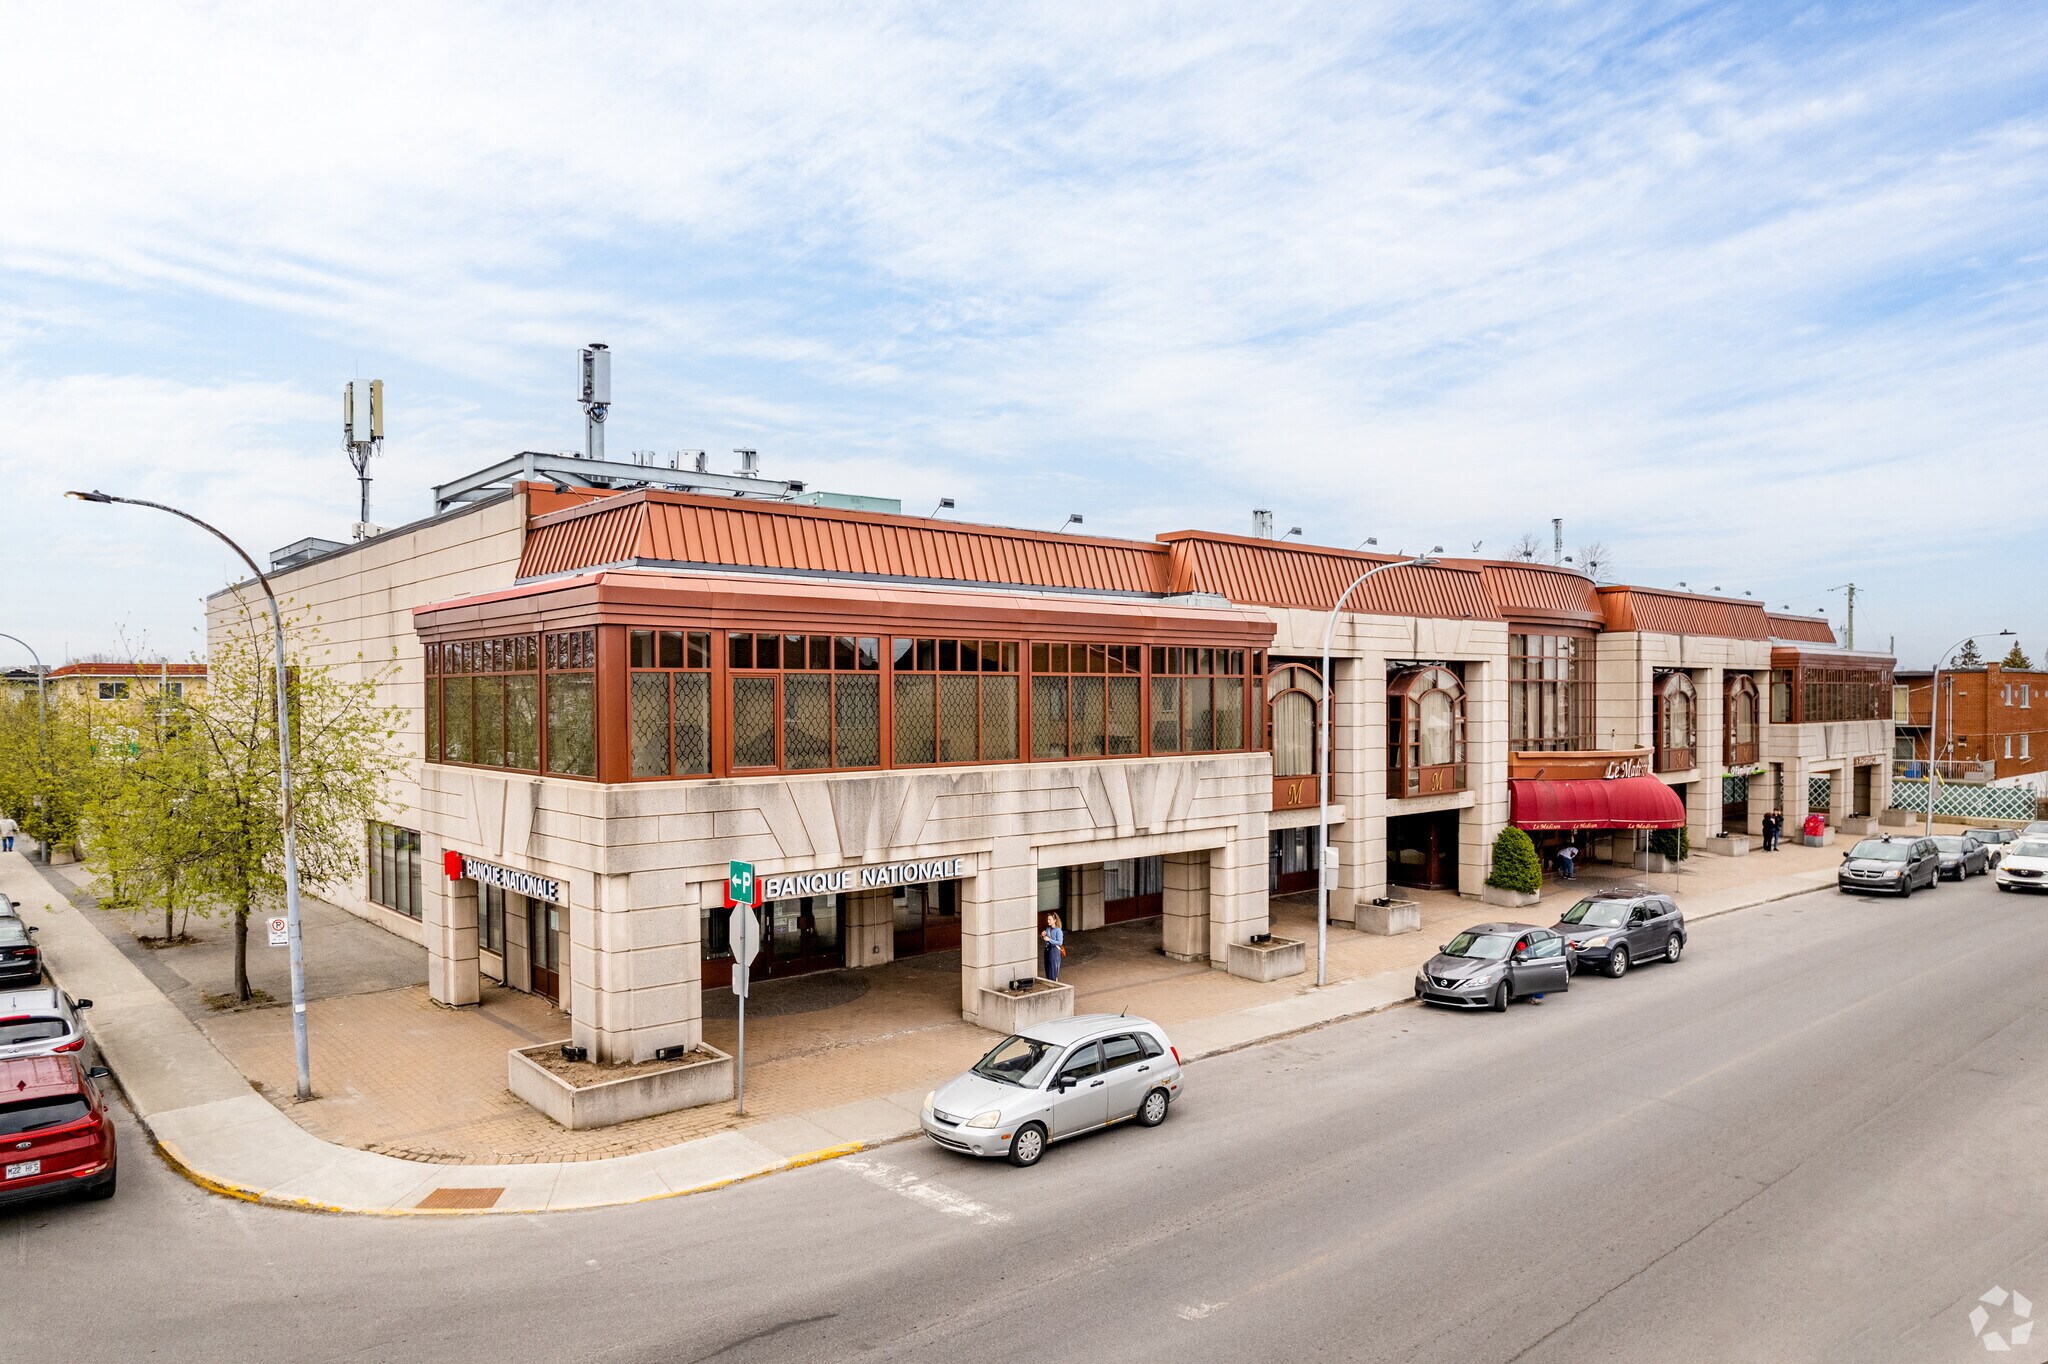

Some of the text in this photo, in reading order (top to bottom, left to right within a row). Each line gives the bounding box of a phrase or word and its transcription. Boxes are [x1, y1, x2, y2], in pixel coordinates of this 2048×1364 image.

[1431, 769, 1445, 791] M
[1606, 761, 1620, 779] Le
[1288, 779, 1304, 805] M
[467, 860, 558, 901] BANQUE NATIONALE
[742, 871, 751, 893] P
[766, 858, 965, 899] BANQUE NATIONALE
